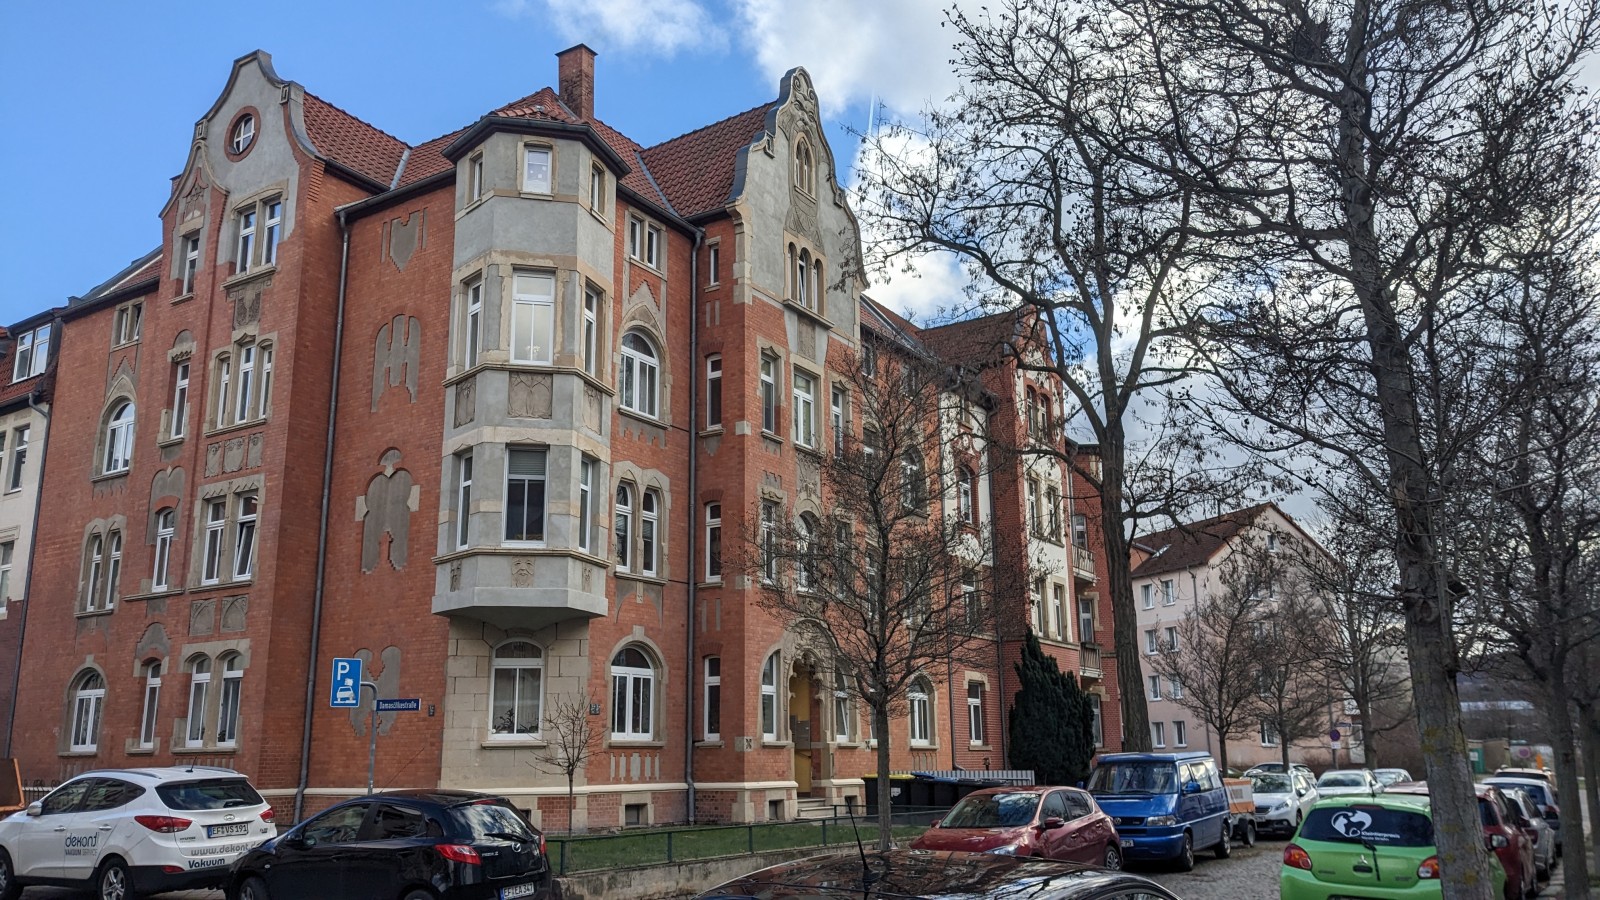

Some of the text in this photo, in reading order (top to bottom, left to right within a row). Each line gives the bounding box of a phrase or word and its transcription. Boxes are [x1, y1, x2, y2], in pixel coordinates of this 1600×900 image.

[337, 661, 350, 681] P
[212, 824, 247, 835] EF VS 191
[188, 858, 225, 869] Vakuum
